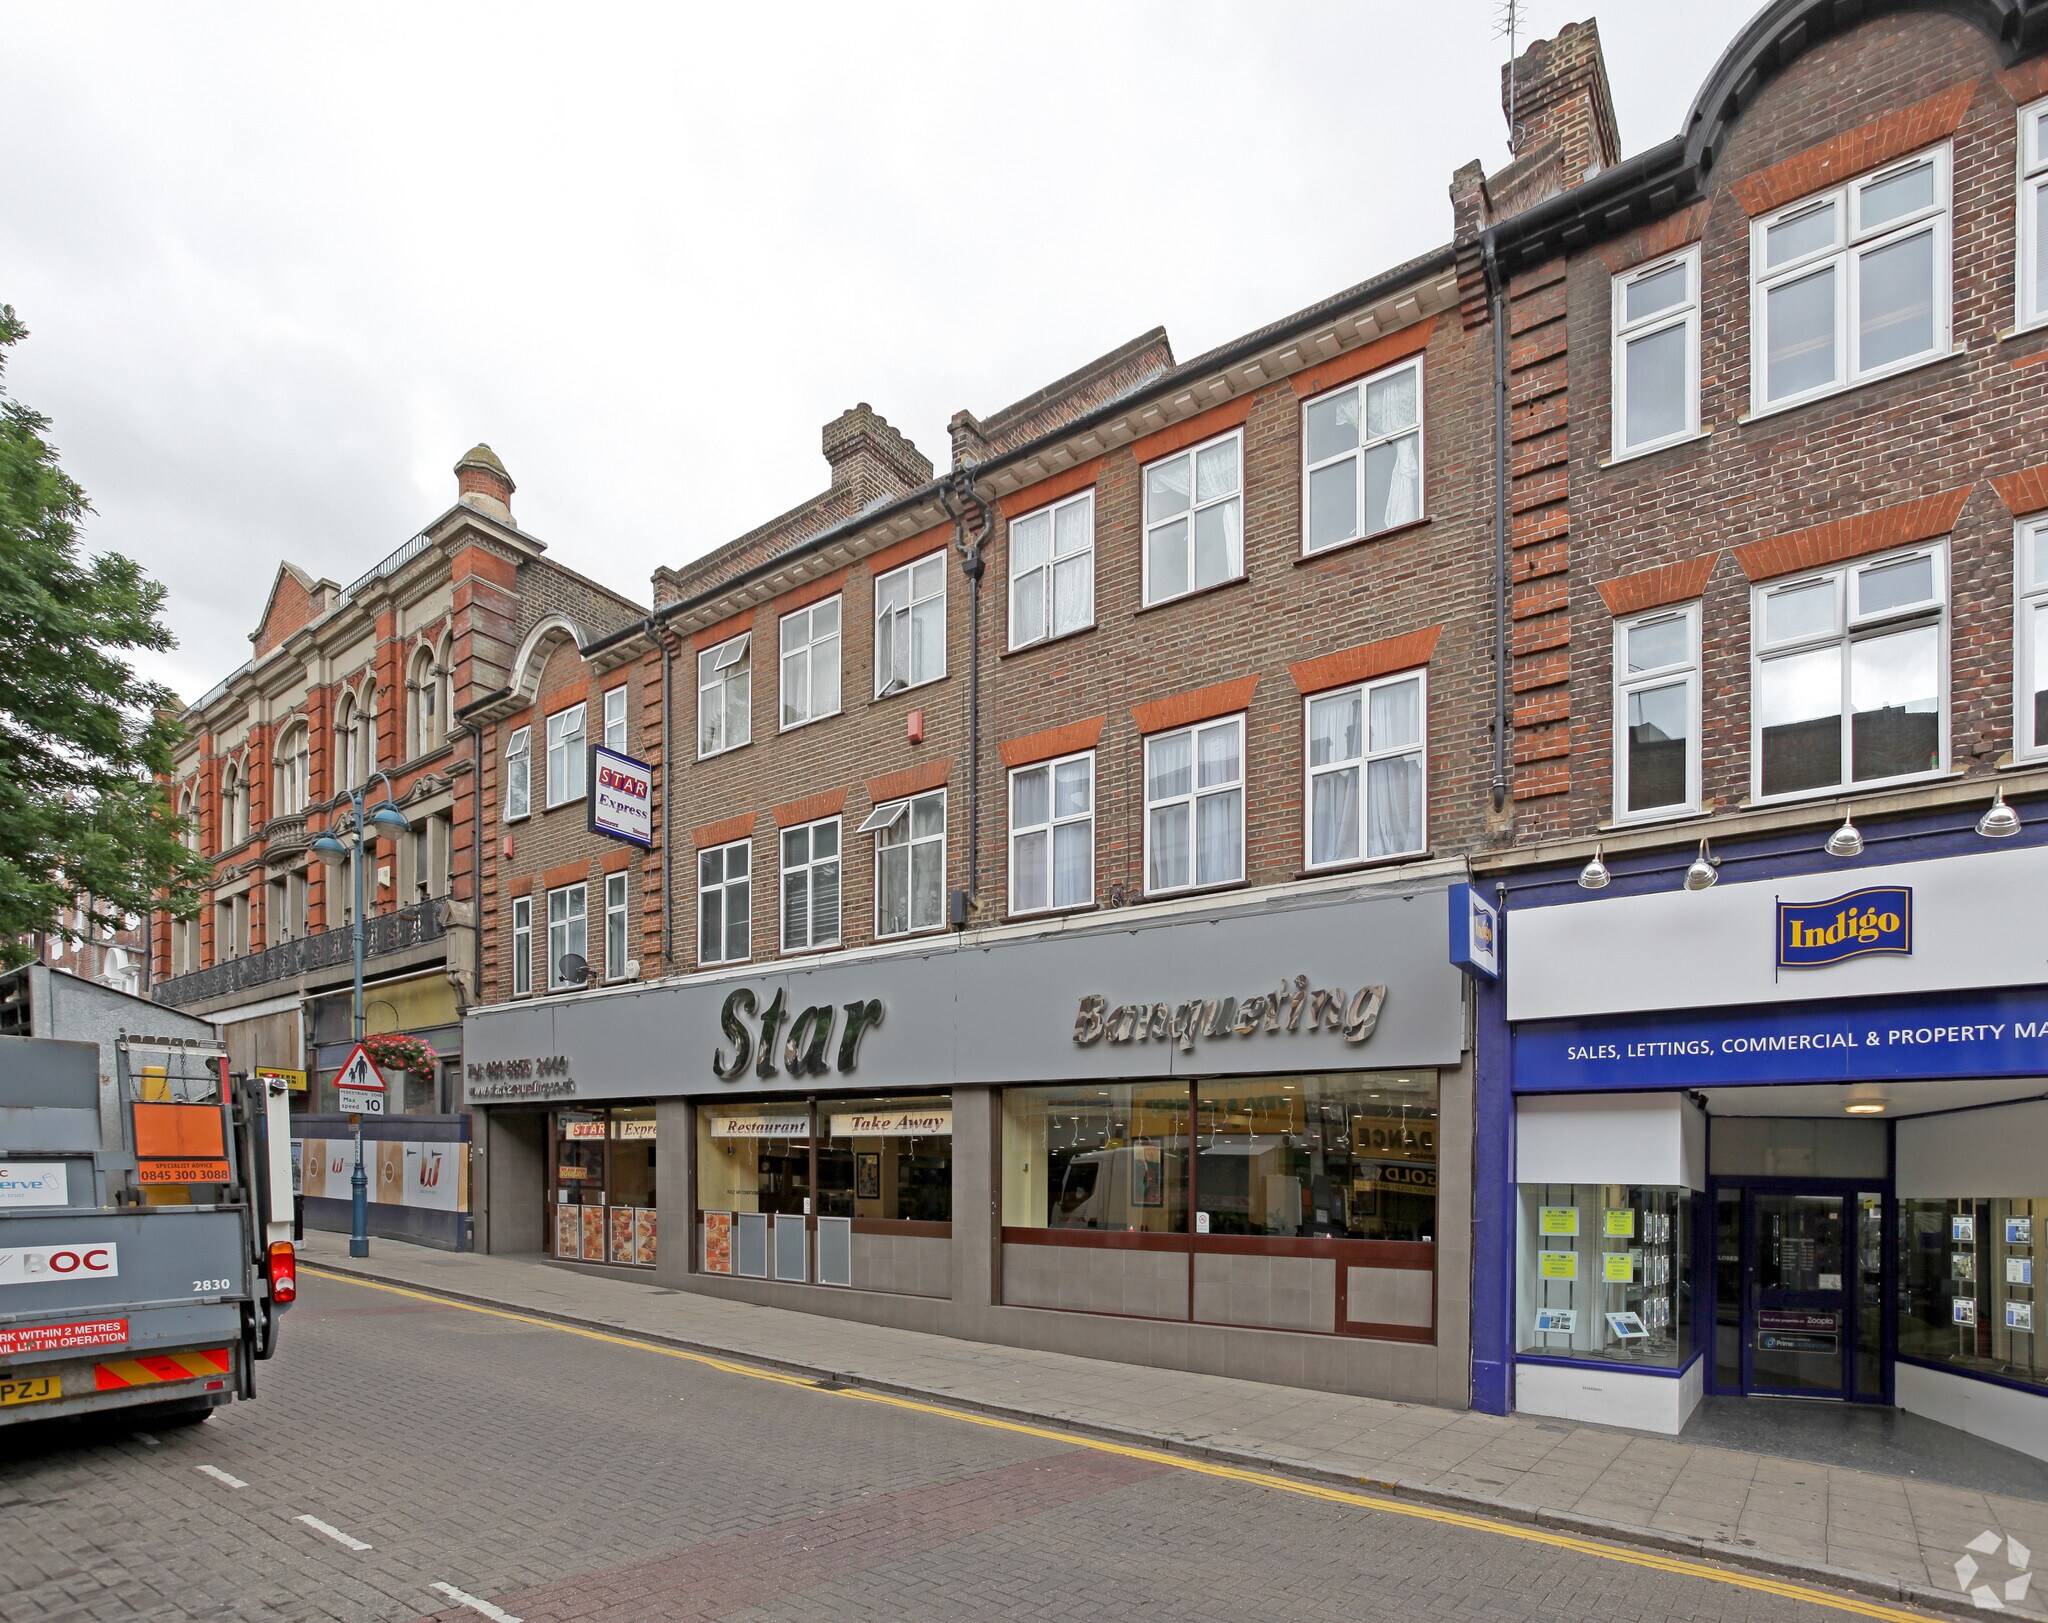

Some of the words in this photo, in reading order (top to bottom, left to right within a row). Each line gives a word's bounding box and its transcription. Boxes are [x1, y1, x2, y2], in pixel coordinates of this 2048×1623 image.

[601, 769, 646, 796] STAR
[599, 793, 648, 819] Express
[1789, 907, 1900, 947] Indigo
[1072, 974, 1388, 1052] Banqueting
[713, 986, 885, 1079] Star
[1567, 1044, 1621, 1060] SALES,
[1627, 1040, 1715, 1058] LETTINGS,
[1721, 1032, 1859, 1053] COMMERCIAL
[1865, 1031, 1881, 1046] &
[1888, 1023, 2006, 1045] PROPERTY
[365, 1099, 381, 1112] 10
[574, 1123, 605, 1135] STAR
[727, 1120, 806, 1134] Restaurant
[852, 1116, 891, 1131] Take
[895, 1114, 944, 1133] Away
[141, 1171, 171, 1181] 0845
[175, 1170, 197, 1180] 300
[200, 1169, 228, 1180] 3088
[24, 1249, 109, 1275] BOC
[192, 1279, 231, 1292] 2830
[1806, 1316, 1834, 1325] Zoopla
[19, 1328, 62, 1341] WITHIN
[64, 1327, 72, 1336] 2
[75, 1322, 121, 1335] METRES
[45, 1340, 57, 1349] IN
[60, 1331, 126, 1347] OPERATION
[0, 1379, 50, 1401] PZJ
